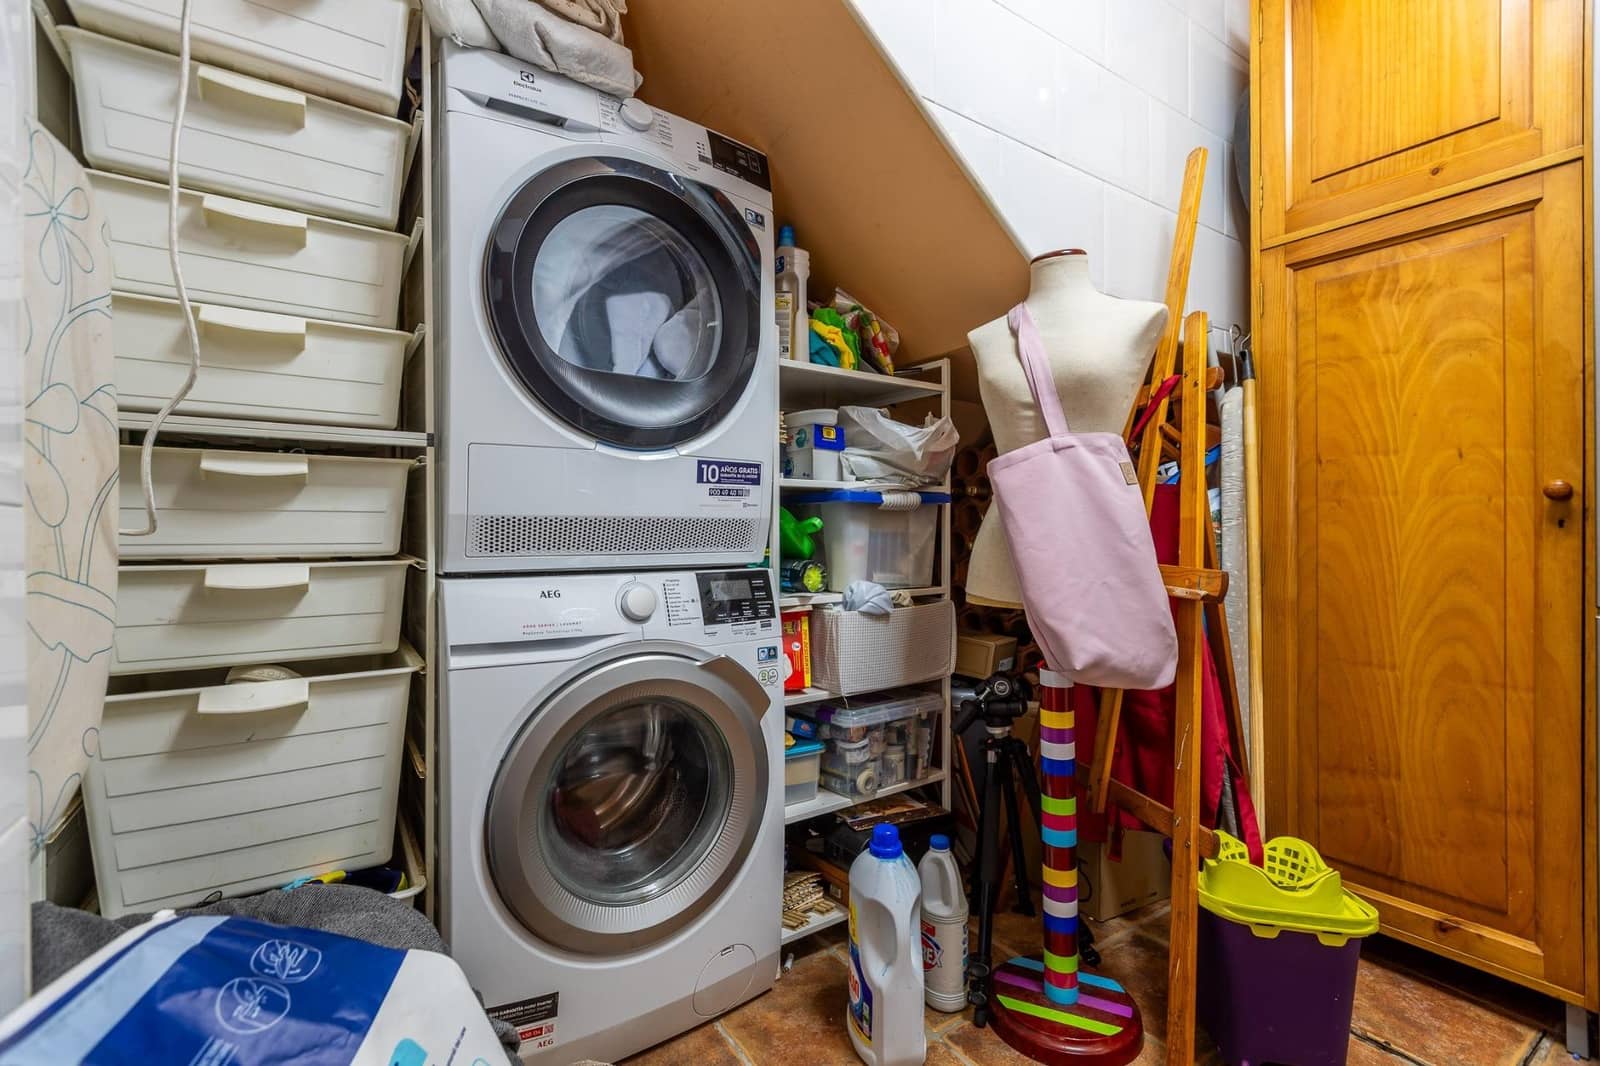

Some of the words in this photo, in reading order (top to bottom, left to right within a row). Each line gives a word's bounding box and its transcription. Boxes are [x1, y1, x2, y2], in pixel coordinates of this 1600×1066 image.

[701, 464, 719, 483] 10
[720, 465, 738, 473] AÑOS
[539, 589, 561, 599] AEG
[537, 1039, 554, 1048] AEG
